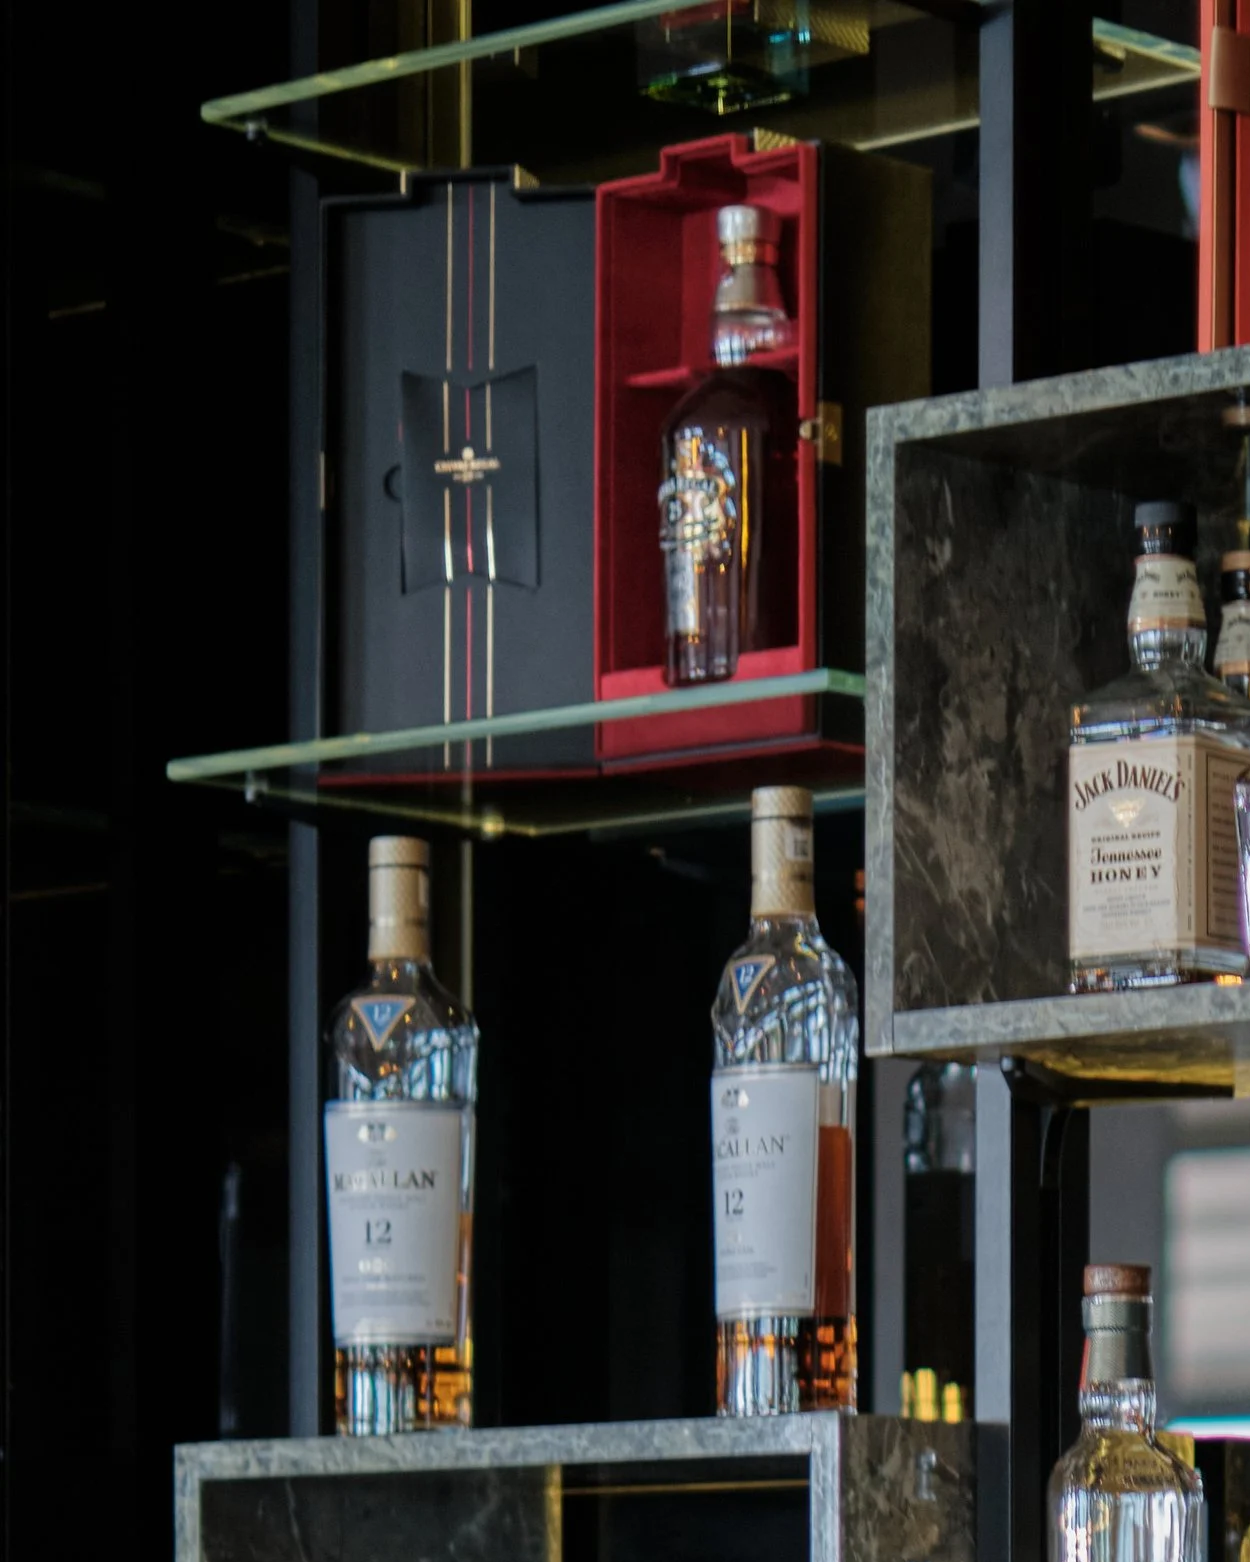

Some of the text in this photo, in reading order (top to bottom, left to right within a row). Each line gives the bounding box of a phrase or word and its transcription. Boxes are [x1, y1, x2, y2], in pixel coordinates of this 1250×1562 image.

[1074, 759, 1186, 812] JACK DANIEL'S
[1090, 847, 1163, 867] Tennessee
[1090, 864, 1163, 886] HONEY
[724, 1187, 744, 1216] 12
[364, 1217, 393, 1245] 12
